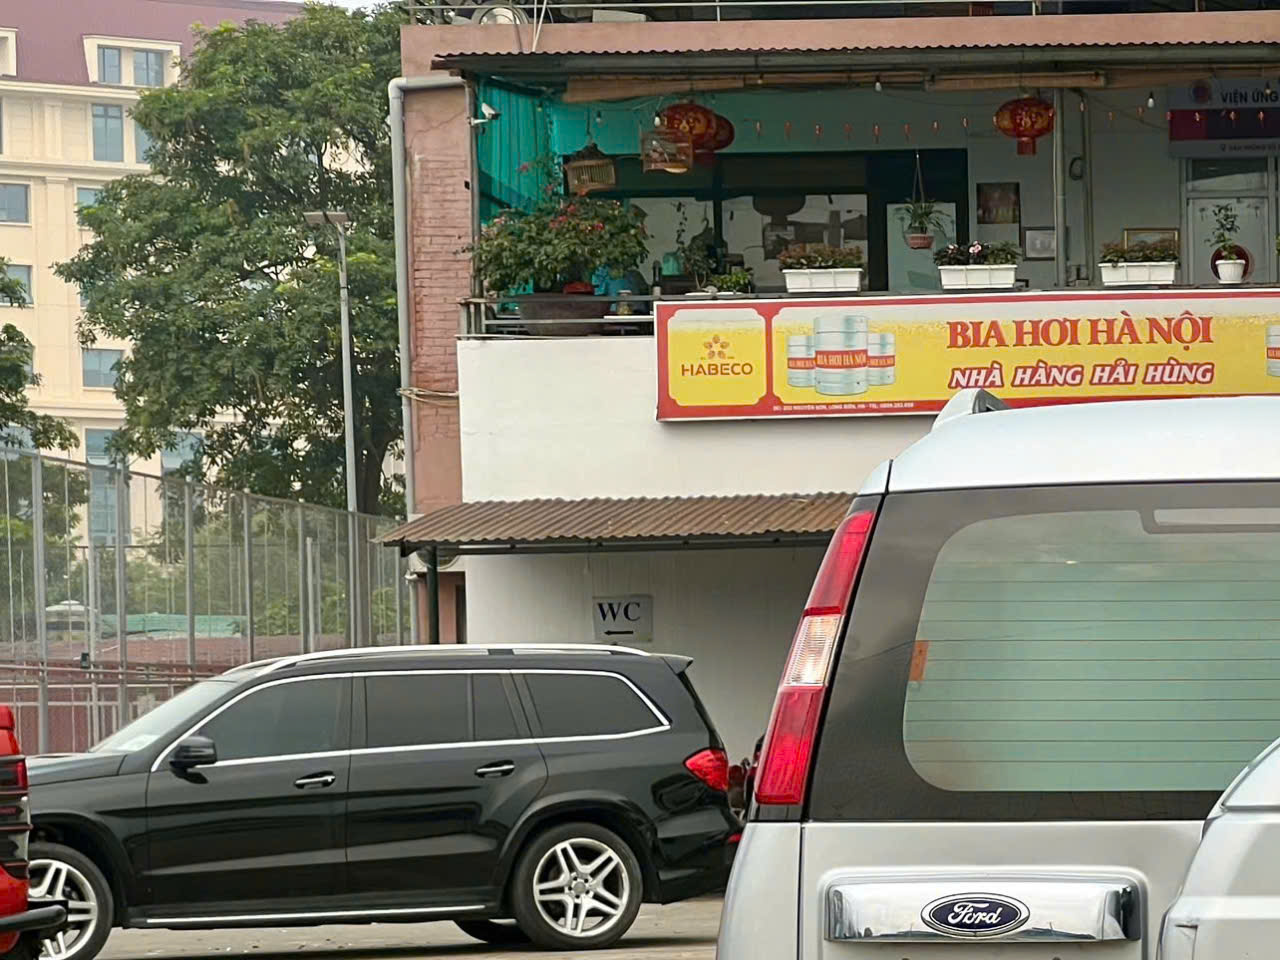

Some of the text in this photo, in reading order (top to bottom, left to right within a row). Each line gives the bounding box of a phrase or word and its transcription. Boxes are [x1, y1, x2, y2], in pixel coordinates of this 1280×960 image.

[1221, 88, 1249, 106] VIỆN
[946, 310, 1214, 351] BIA HƠI HÀ NỘI
[681, 362, 753, 376] HABECO
[948, 356, 1215, 388] NHÀ HÀNG HẢI HÙNG
[597, 601, 641, 622] WC
[947, 902, 1003, 924] Ford
